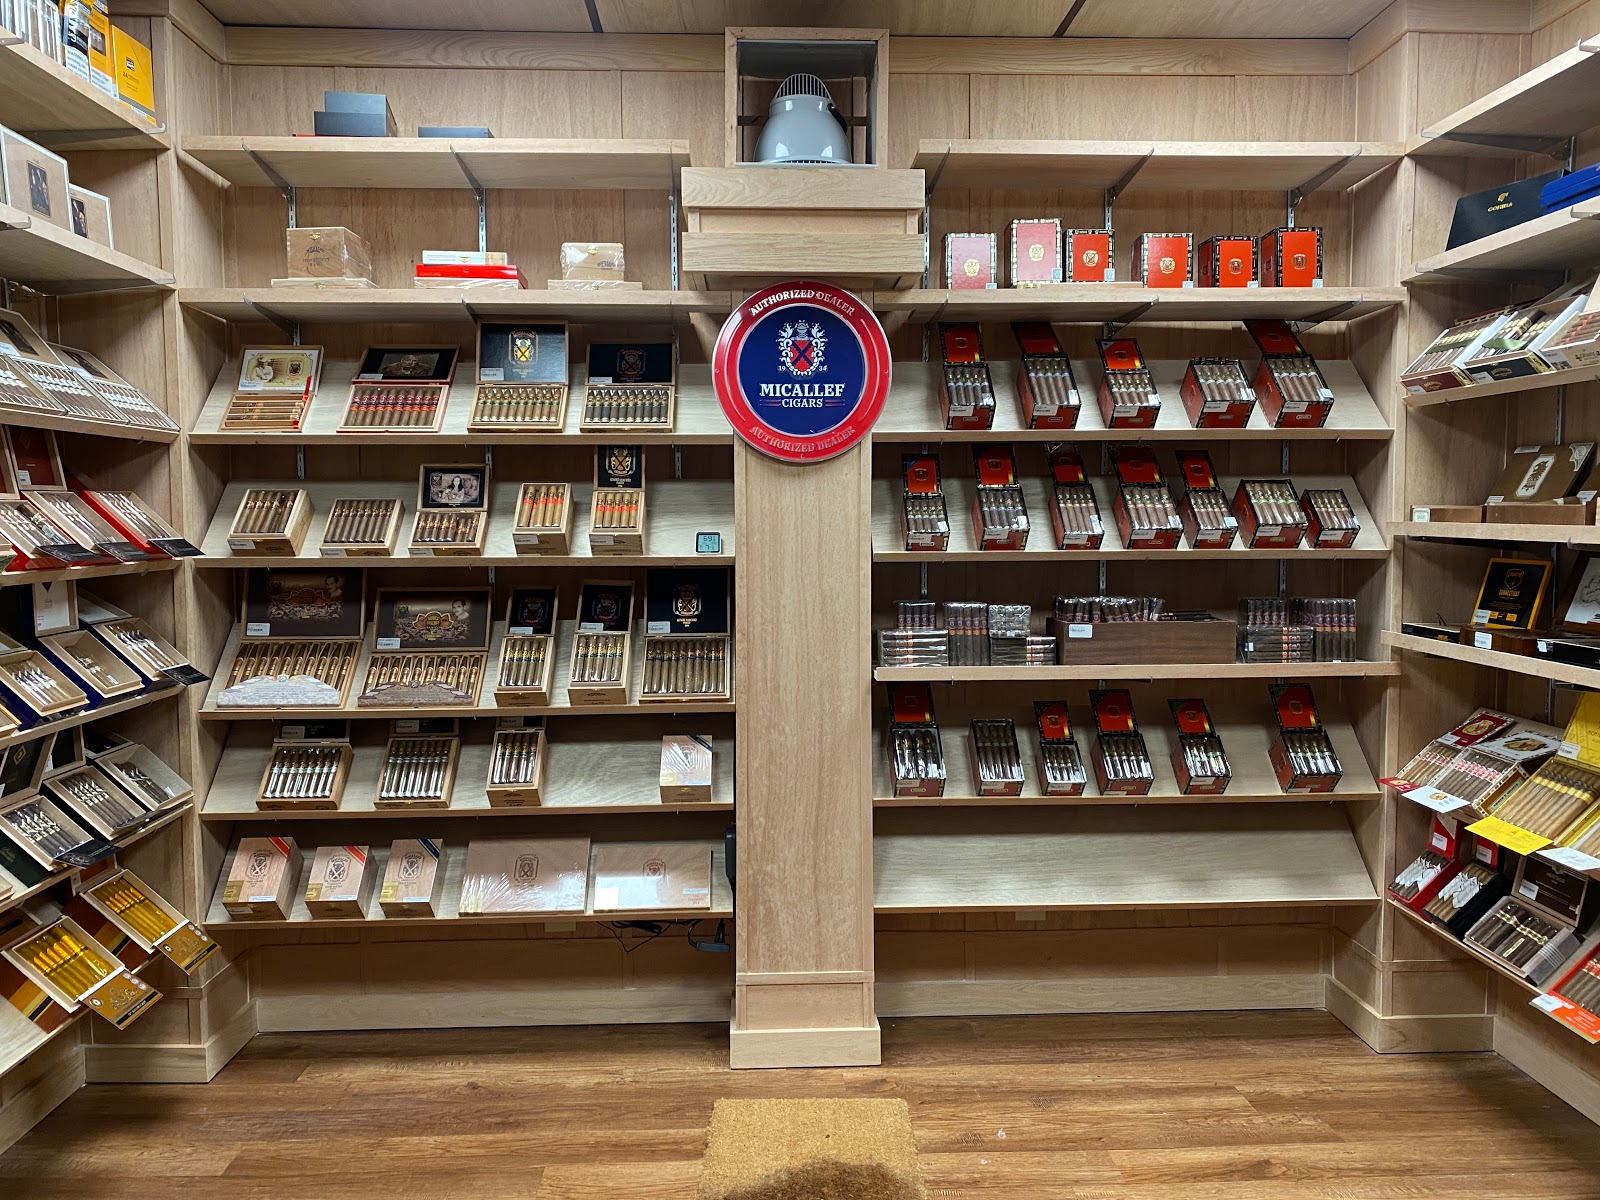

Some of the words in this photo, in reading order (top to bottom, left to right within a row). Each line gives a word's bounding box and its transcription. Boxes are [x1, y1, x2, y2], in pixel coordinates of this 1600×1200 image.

[748, 289, 814, 317] AUTHORIZED
[816, 291, 855, 317] DEALER
[759, 383, 846, 397] MICALLEF
[780, 398, 824, 408] CIGARS
[749, 426, 815, 453] AUTHORIZED
[817, 425, 856, 452] DEALER
